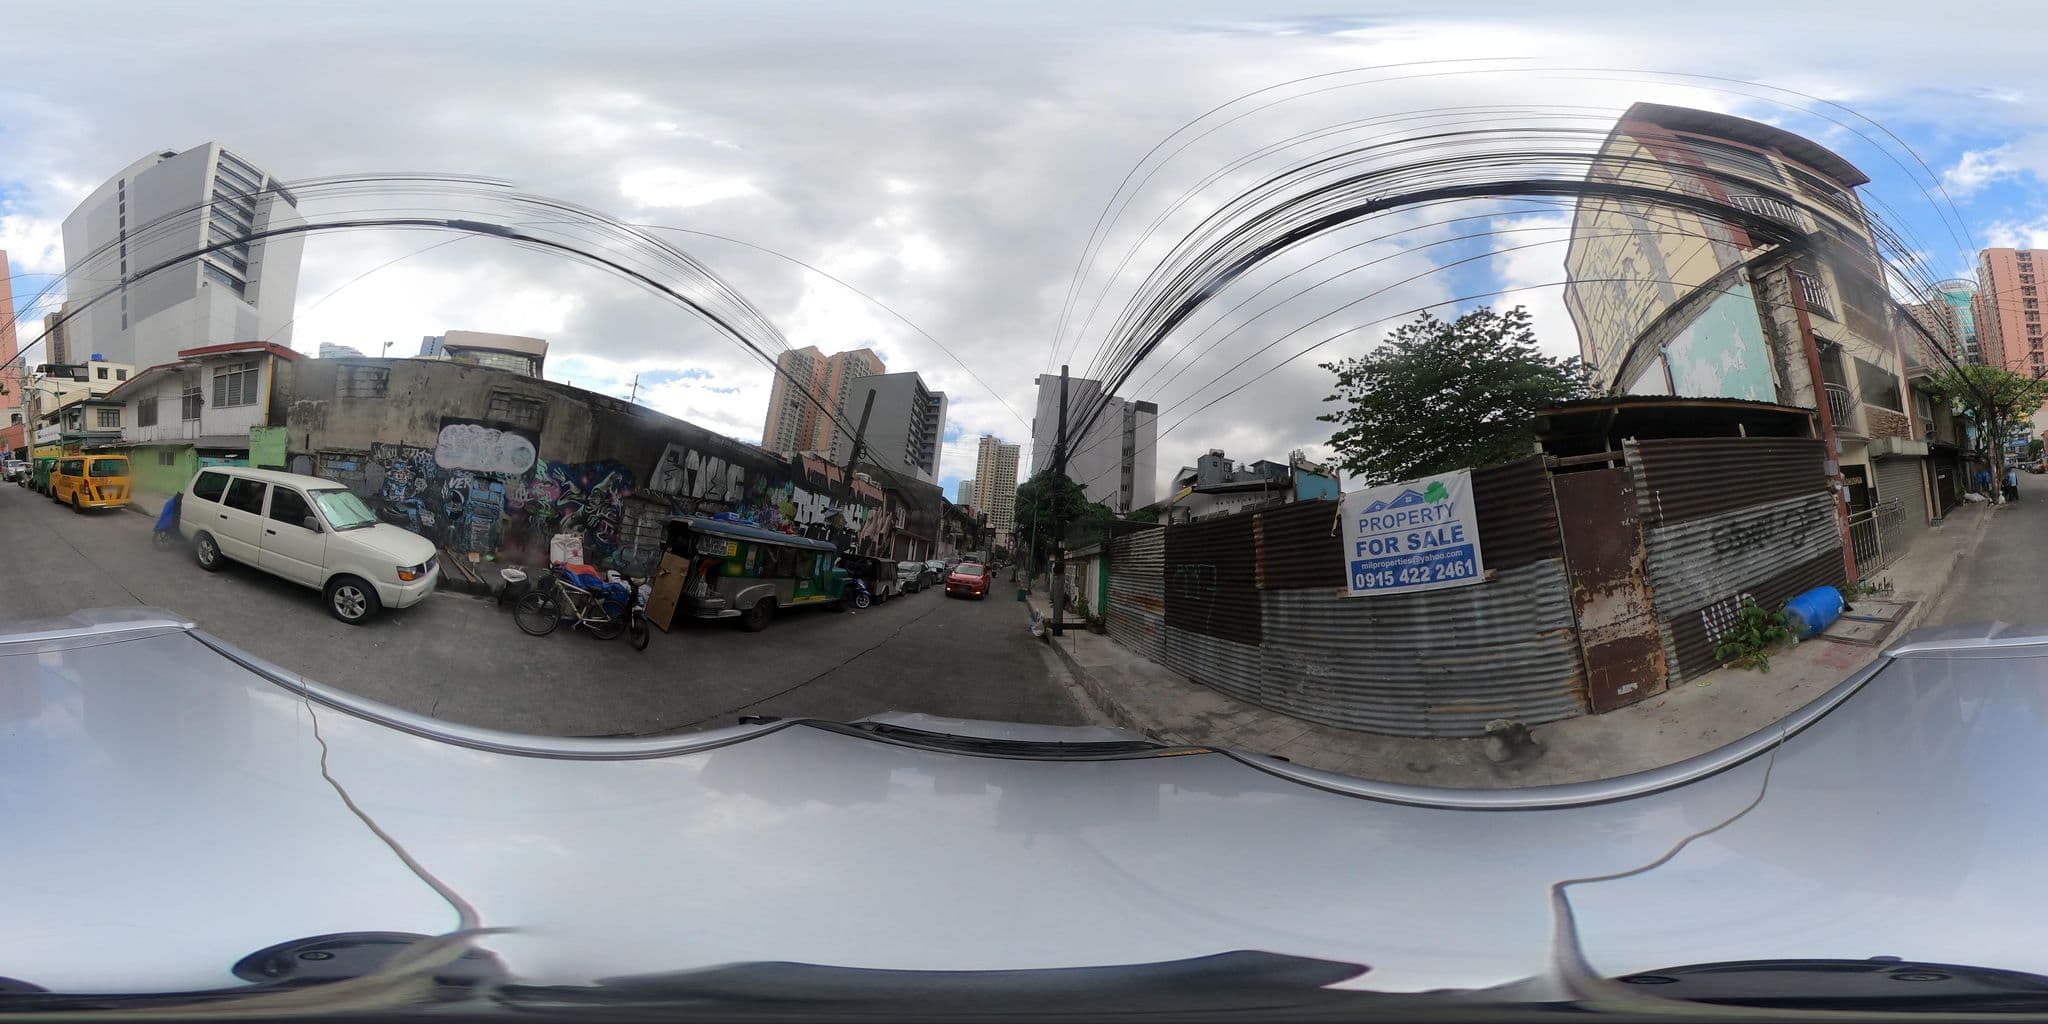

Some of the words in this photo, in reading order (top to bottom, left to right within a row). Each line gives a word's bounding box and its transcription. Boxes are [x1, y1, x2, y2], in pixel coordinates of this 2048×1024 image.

[1359, 502, 1454, 533] PROPERTY
[1356, 536, 1400, 558] FOR
[1407, 525, 1465, 551] SALE
[1355, 573, 1394, 588] 0915
[1399, 566, 1431, 584] 422
[1435, 558, 1474, 580] 2461
[1361, 549, 1463, 570] milproperties@yahoo.com
